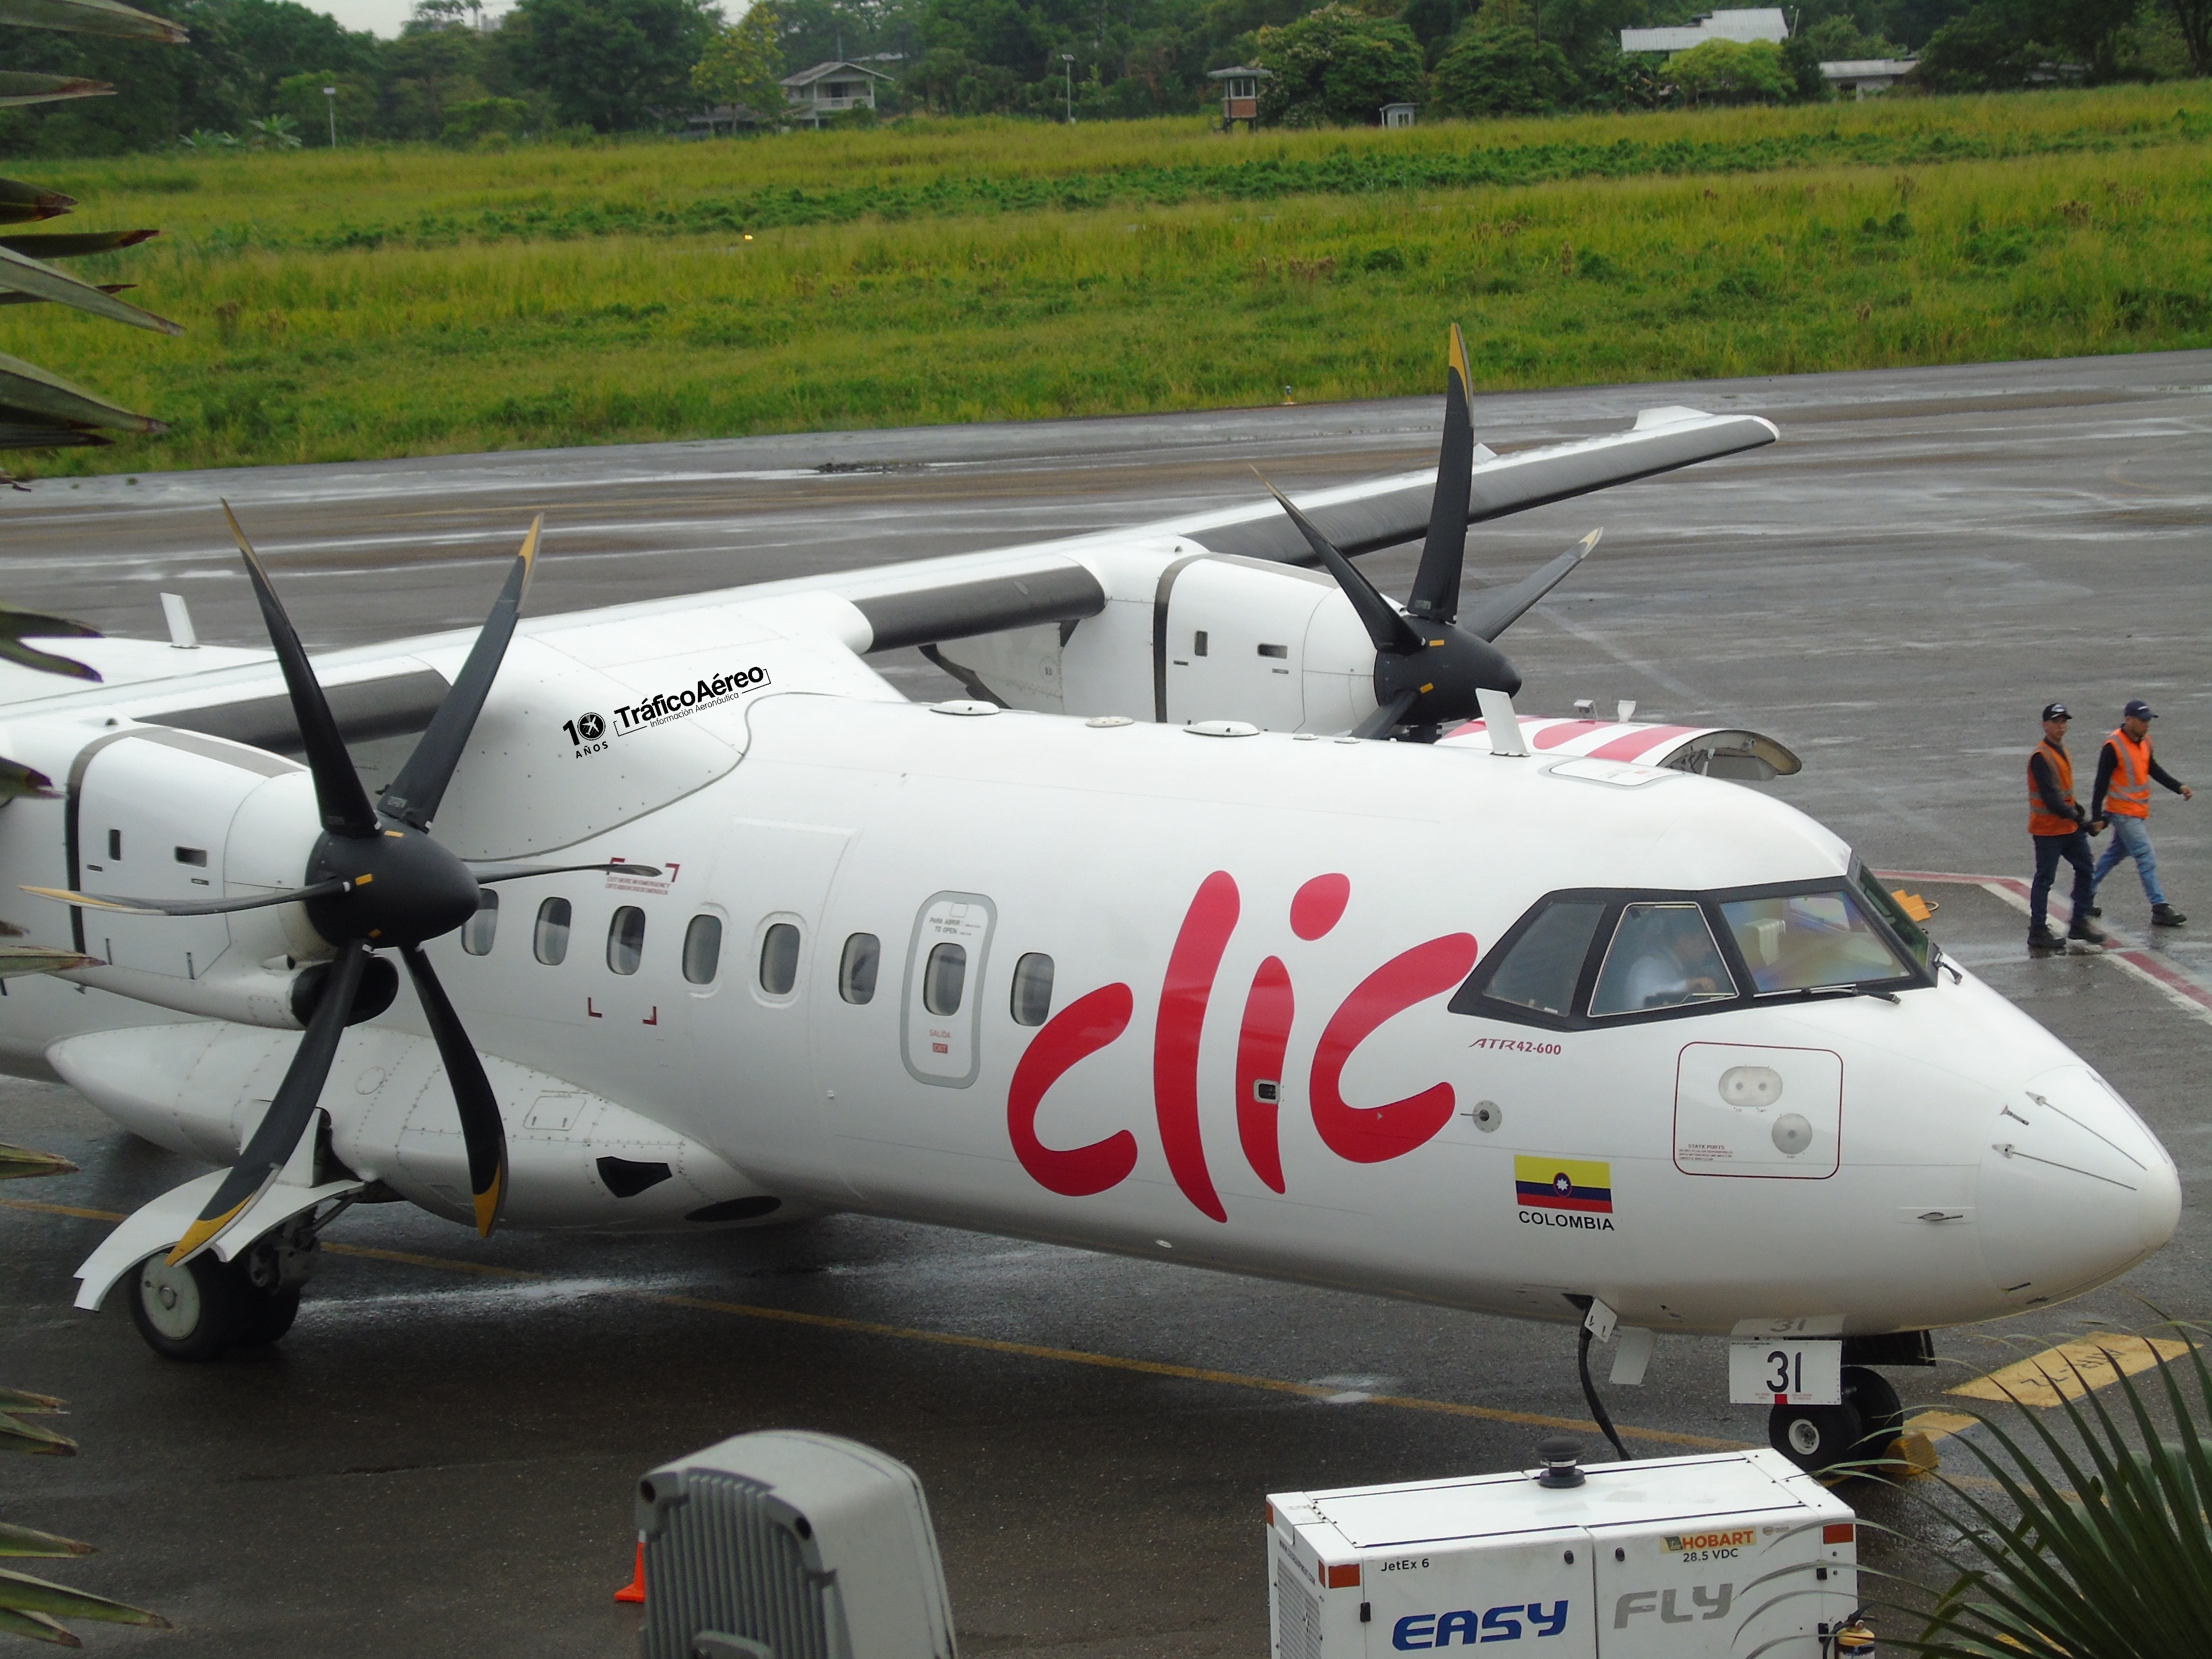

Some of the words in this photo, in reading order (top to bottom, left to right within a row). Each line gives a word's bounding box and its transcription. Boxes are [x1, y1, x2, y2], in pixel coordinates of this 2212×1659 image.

[1007, 870, 1478, 1223] clic
[1519, 1211, 1615, 1231] COLOMBIA
[1766, 1351, 1802, 1393] 31
[1682, 1530, 1754, 1550] HOBART
[1381, 1560, 1417, 1572] JetEx
[1422, 1558, 1430, 1568] 6
[1683, 1551, 1709, 1563] 28.5
[1713, 1548, 1739, 1559] VDC
[1392, 1600, 1569, 1651] EASY
[1613, 1583, 1734, 1630] FLY
